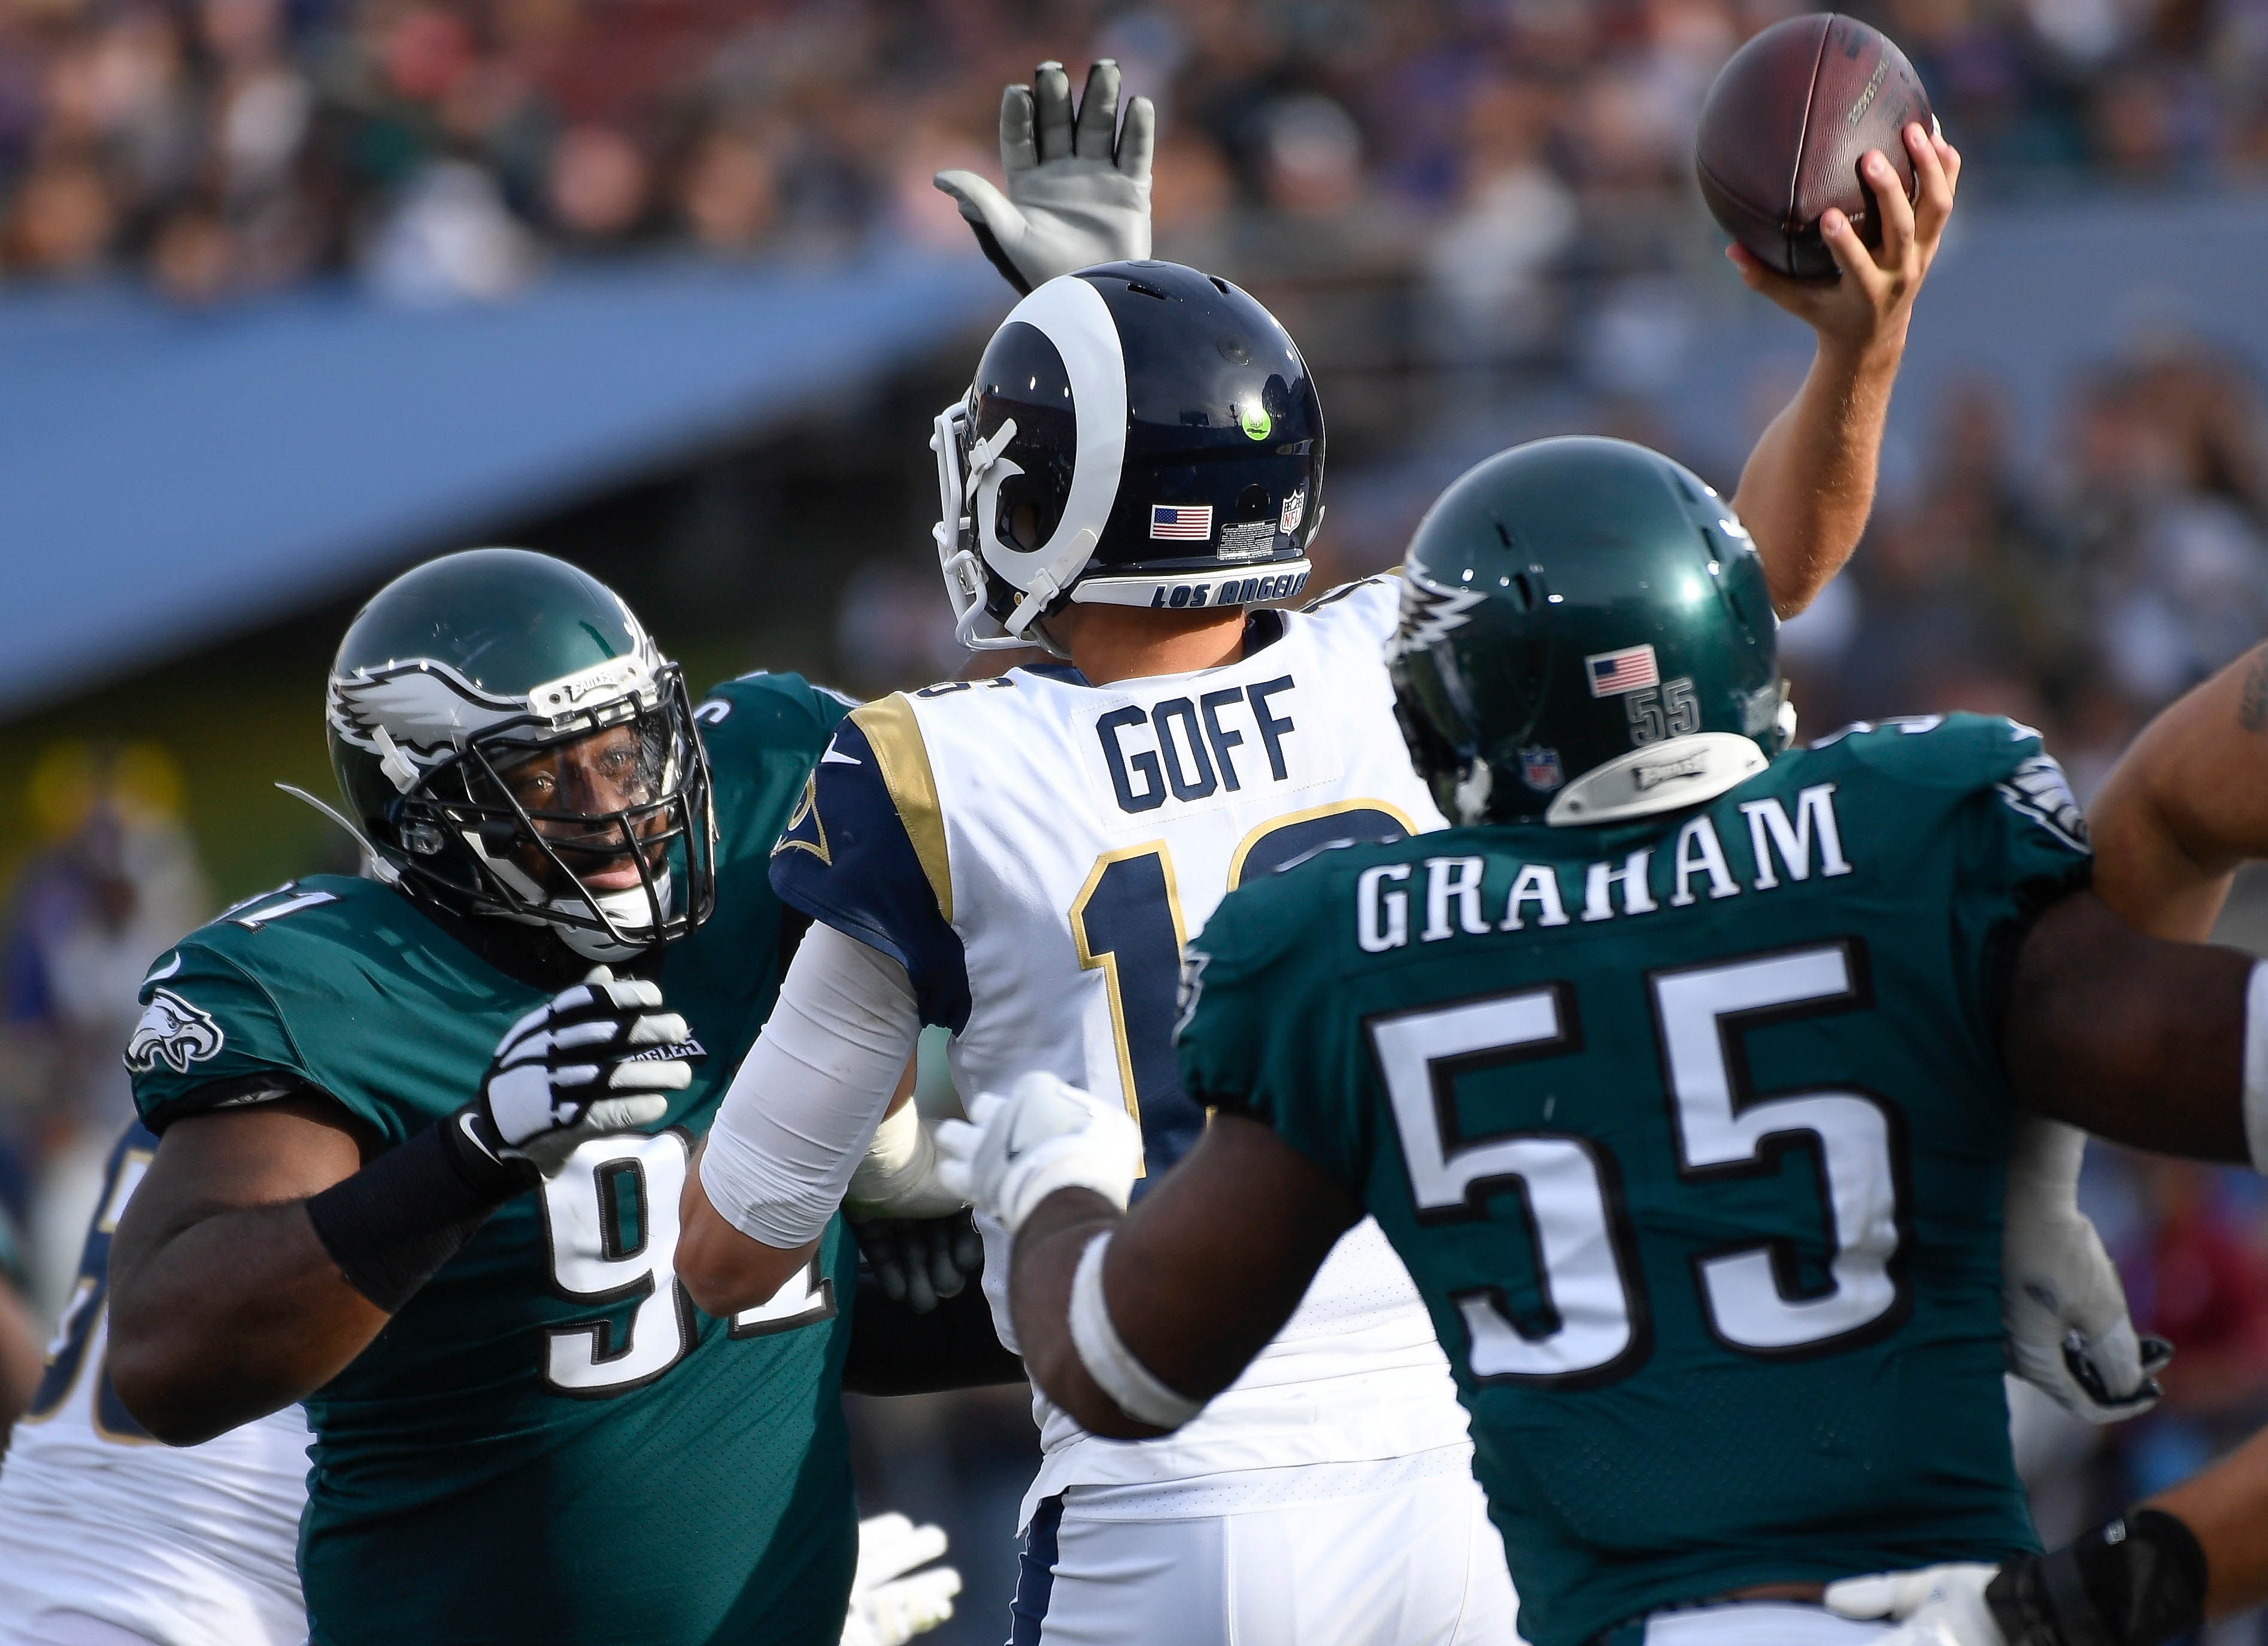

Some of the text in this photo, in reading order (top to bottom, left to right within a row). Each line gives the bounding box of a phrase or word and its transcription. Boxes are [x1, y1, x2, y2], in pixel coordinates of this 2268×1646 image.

[1283, 509, 1299, 529] NFL
[1151, 585, 1211, 608] LOS
[1095, 674, 1296, 814] GOFF
[1625, 675, 1702, 748] 55
[1357, 783, 1854, 953] GRAHAM
[1365, 937, 1910, 1388] 55
